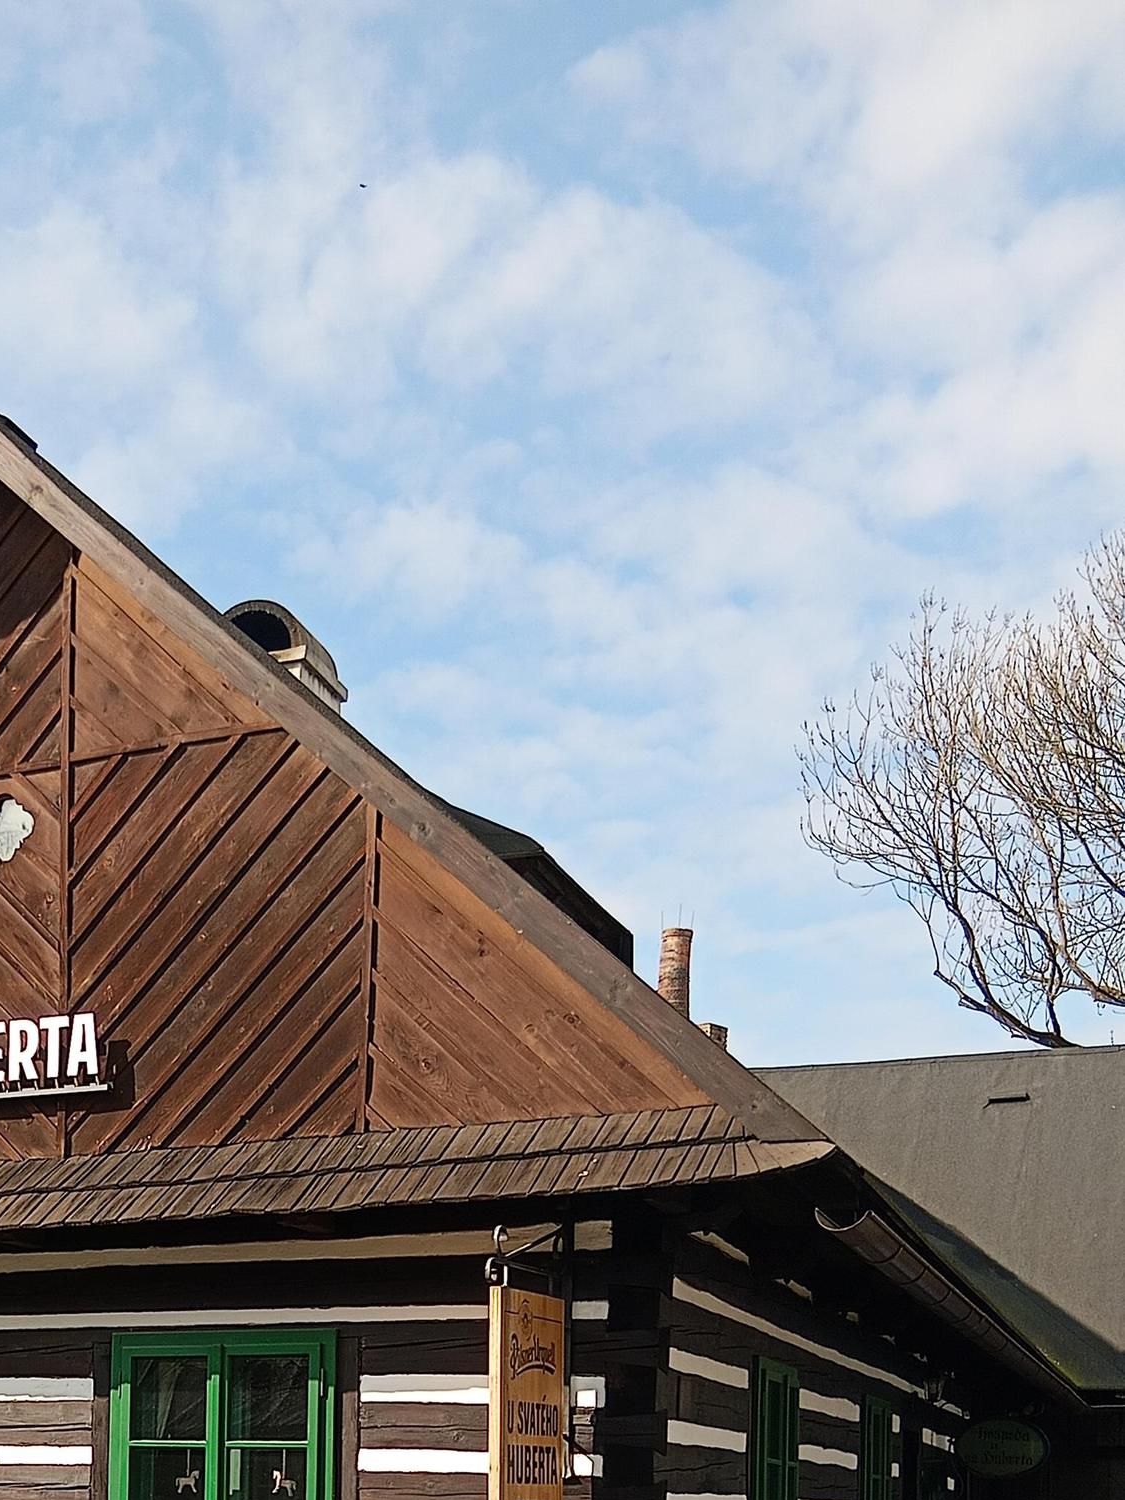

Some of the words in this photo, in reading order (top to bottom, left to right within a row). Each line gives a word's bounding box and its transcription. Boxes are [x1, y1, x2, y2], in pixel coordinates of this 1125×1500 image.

[507, 1400, 514, 1434] U
[517, 1394, 558, 1437] SVATÉHO
[507, 1444, 558, 1485] HUBERTA
